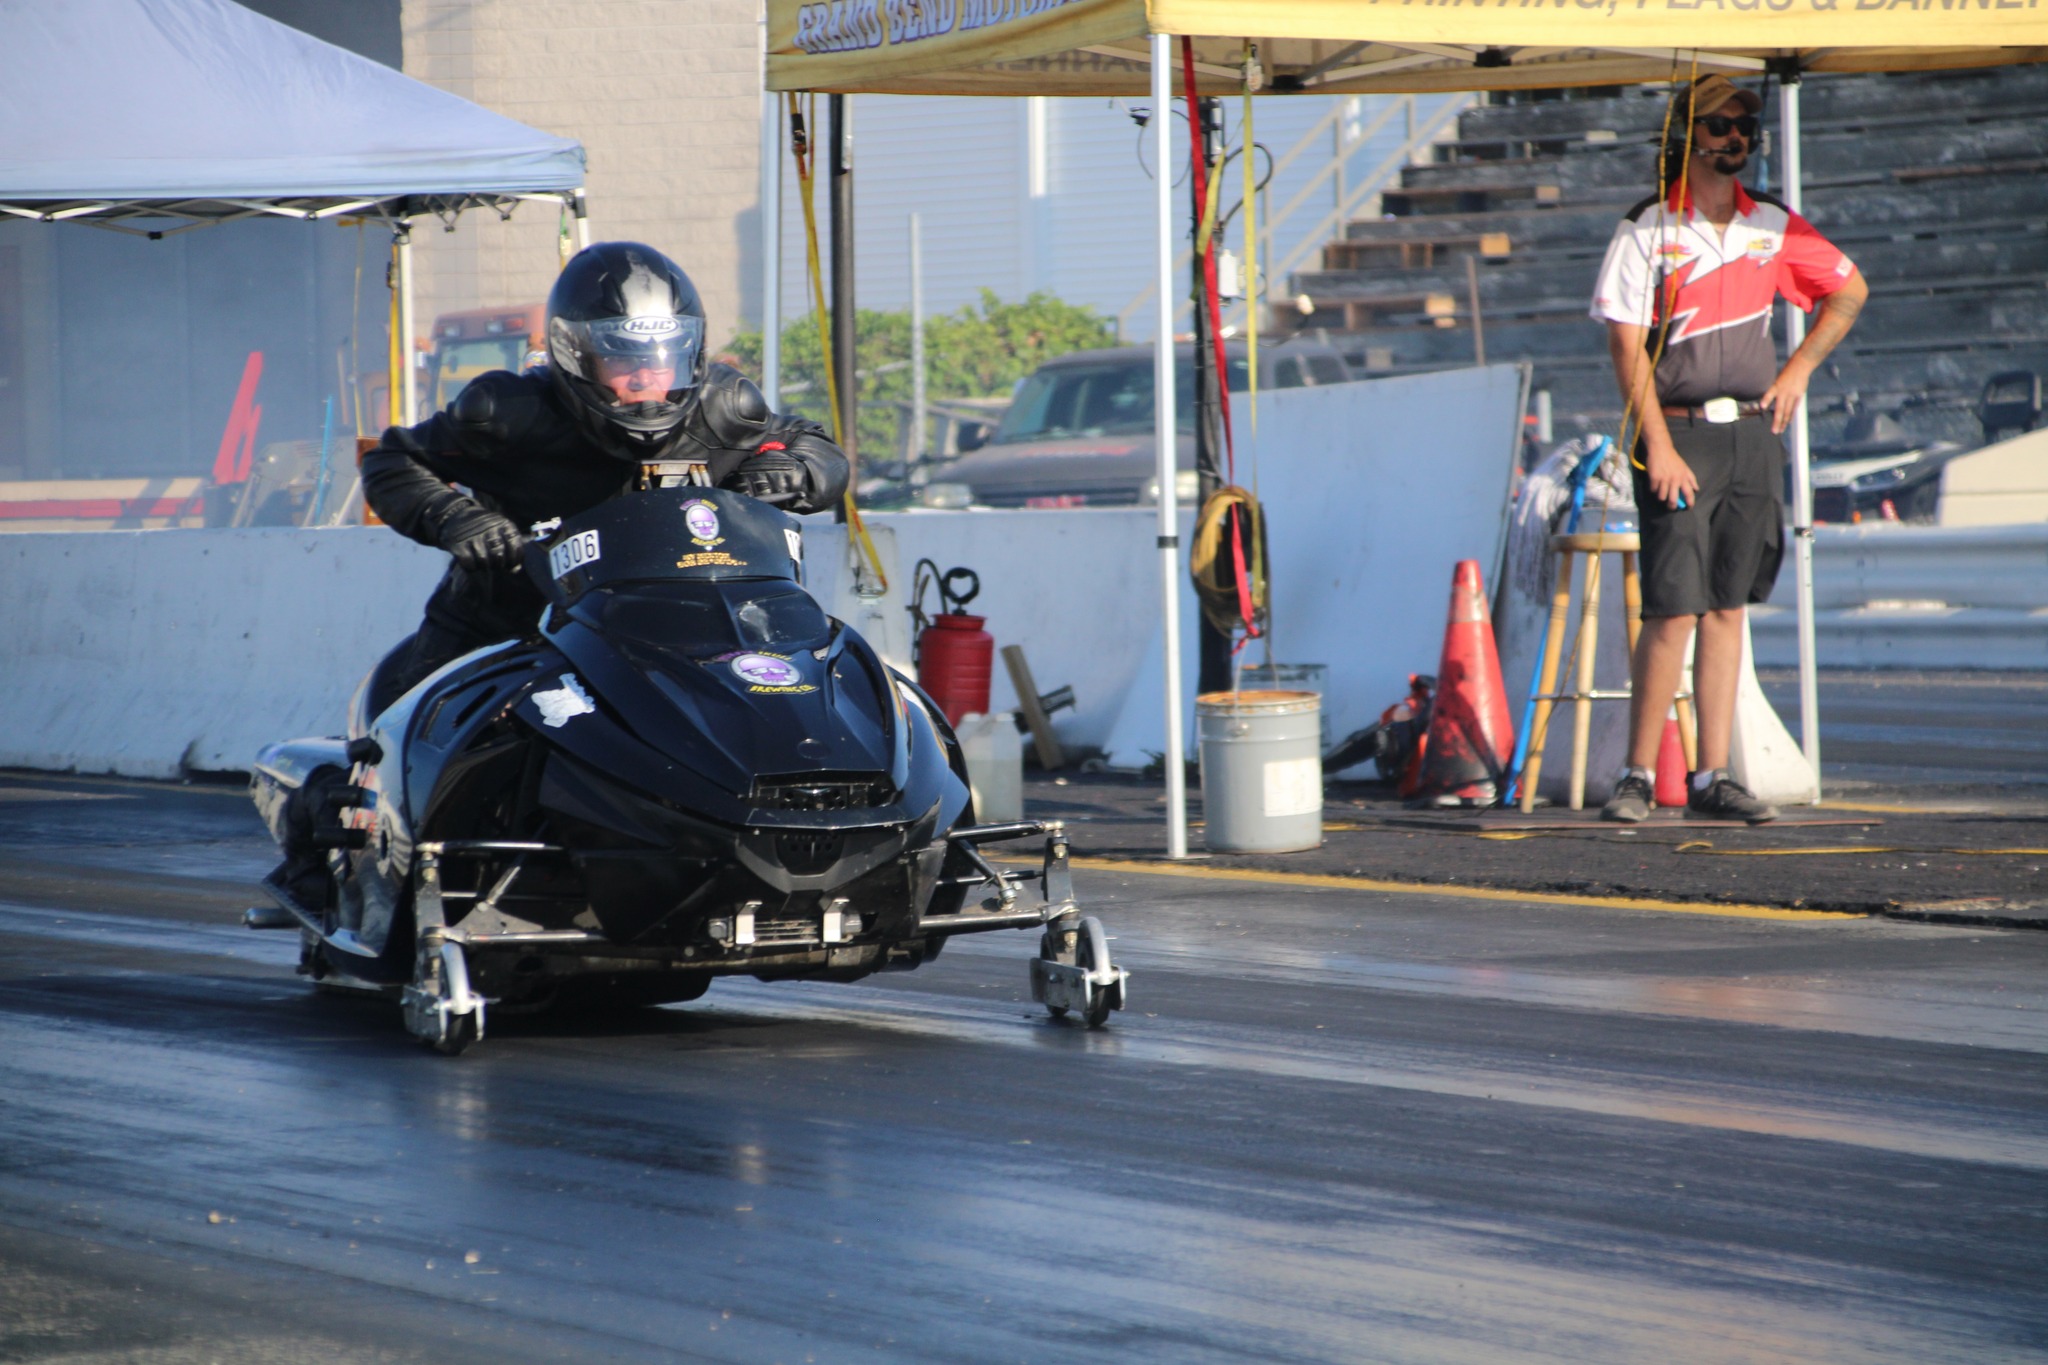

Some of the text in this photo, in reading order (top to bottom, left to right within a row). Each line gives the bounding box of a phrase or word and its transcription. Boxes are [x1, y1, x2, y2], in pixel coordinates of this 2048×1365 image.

[792, 0, 884, 54] GRAND
[885, 0, 956, 45] BEND
[630, 321, 672, 330] HJC
[553, 533, 595, 574] 1306
